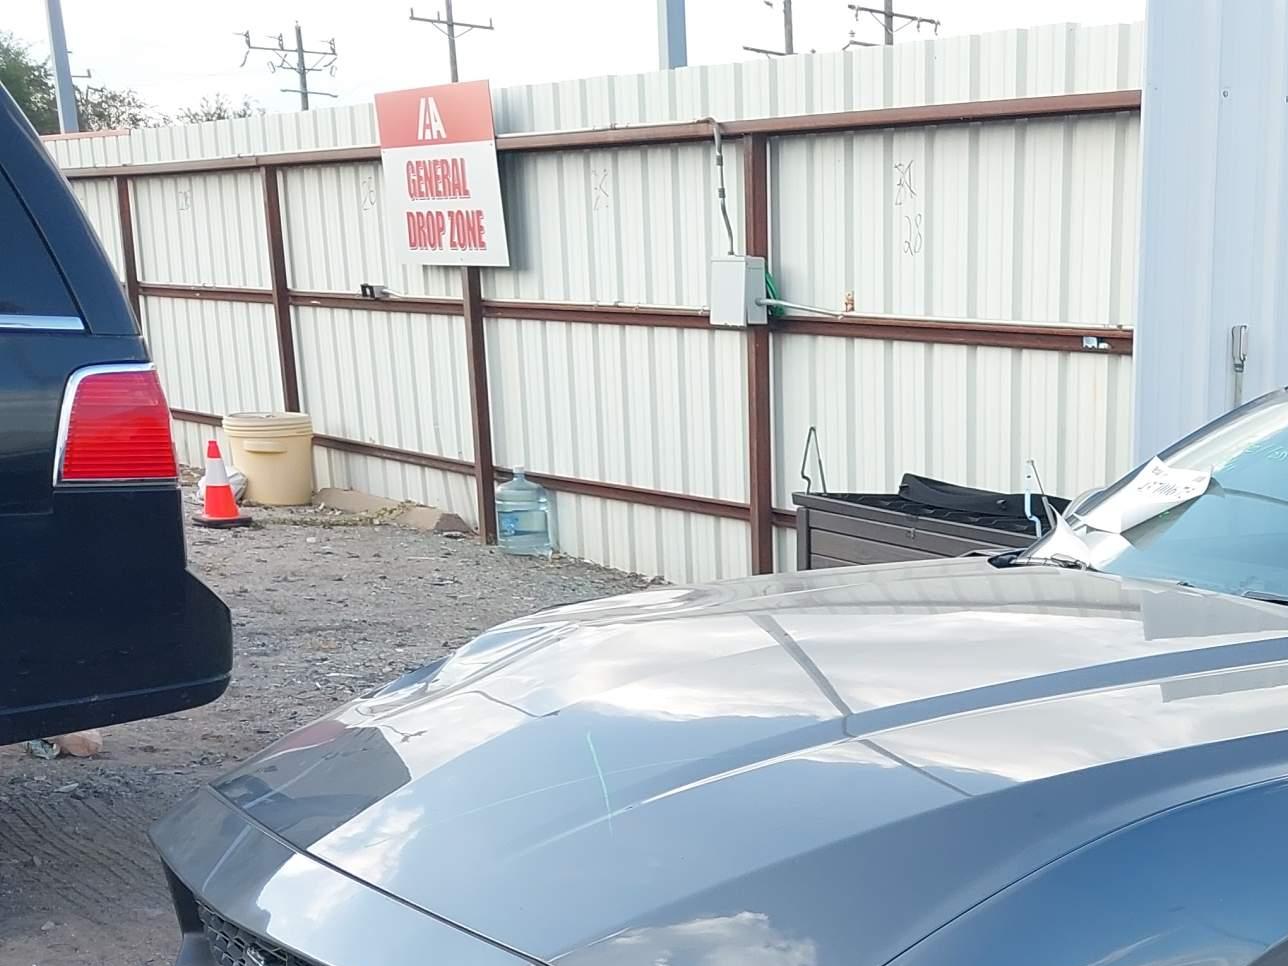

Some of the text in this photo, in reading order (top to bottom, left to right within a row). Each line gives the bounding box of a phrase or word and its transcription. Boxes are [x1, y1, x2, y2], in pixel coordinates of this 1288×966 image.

[406, 158, 471, 200] GENERAL
[406, 209, 487, 251] DROP ZONE
